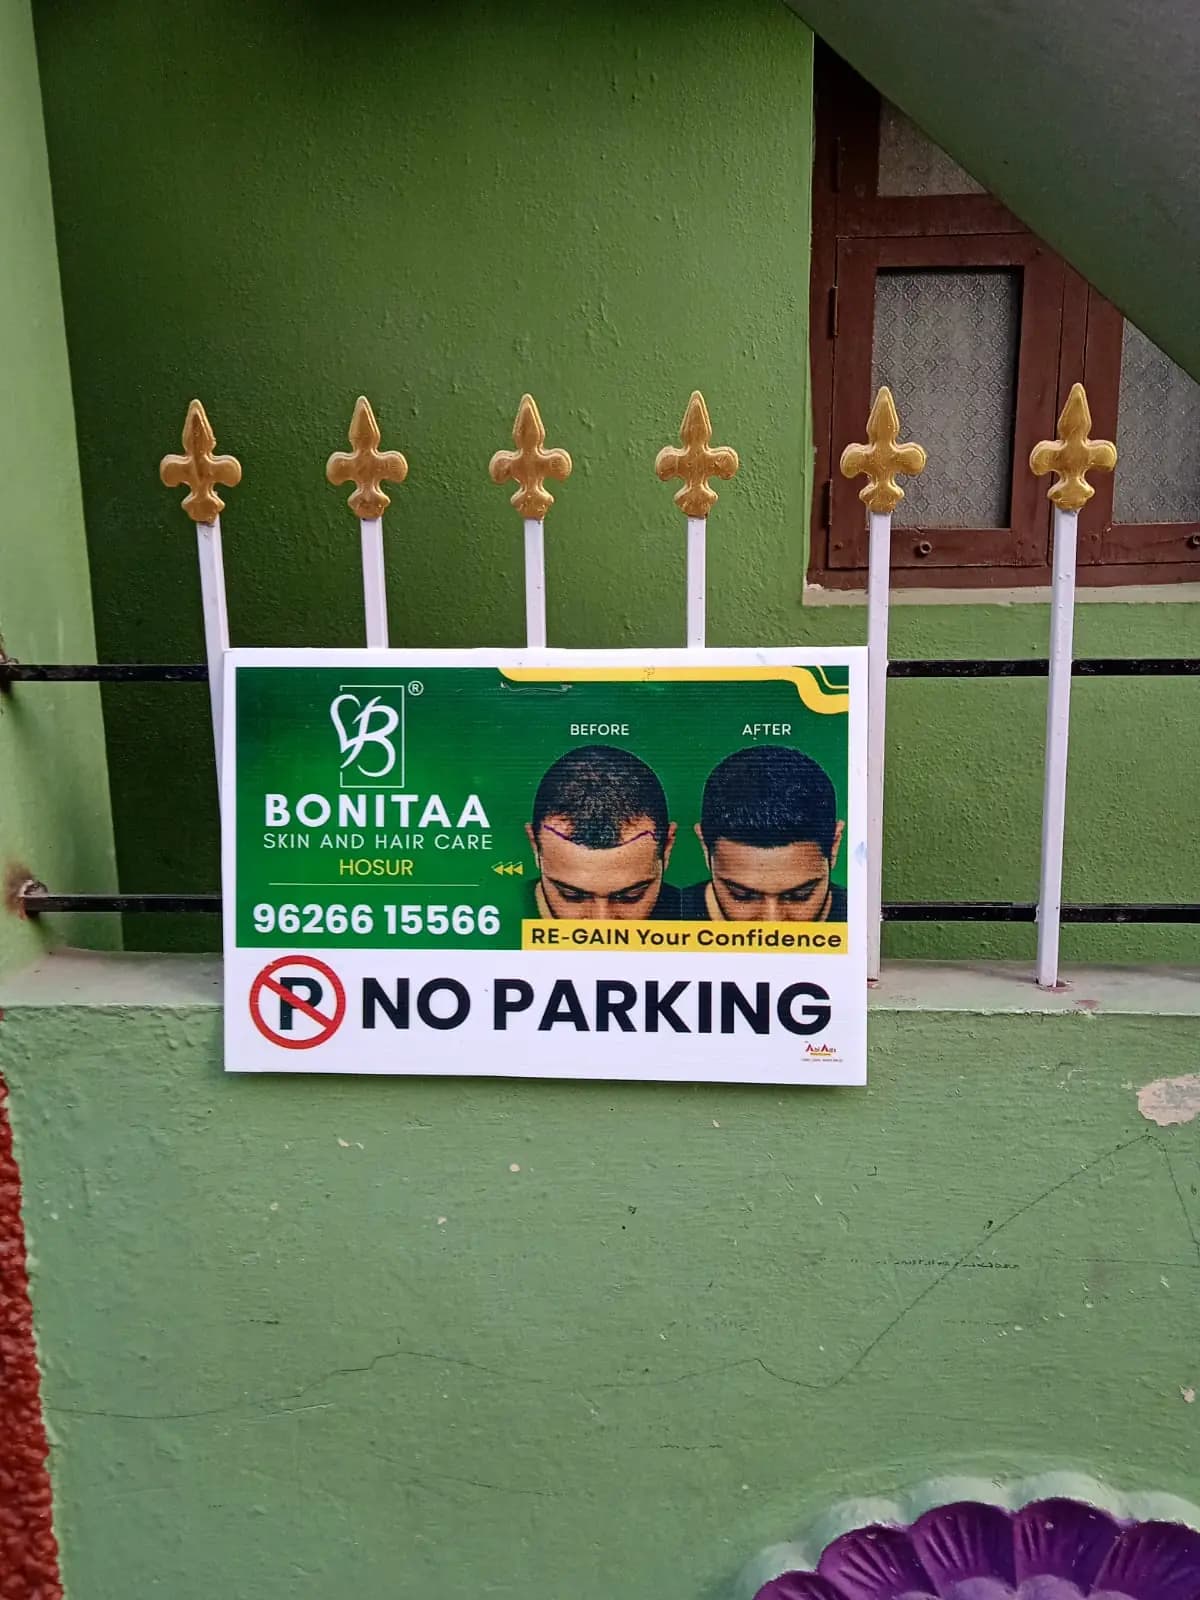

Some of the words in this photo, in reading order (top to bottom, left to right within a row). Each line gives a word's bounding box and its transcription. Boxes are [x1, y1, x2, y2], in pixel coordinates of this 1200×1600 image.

[569, 723, 630, 737] BEFORE
[742, 723, 792, 737] AFTER
[265, 793, 491, 828] BONITAA
[263, 833, 310, 849] SKIN
[320, 834, 365, 849] AND
[375, 834, 425, 850] HAIR
[434, 834, 494, 850] CARE
[339, 859, 414, 876] HOSUR
[253, 903, 374, 934] 96266
[384, 904, 501, 935] 15566
[531, 927, 630, 946] RE-GAIN
[636, 928, 691, 947] Your
[697, 929, 842, 948] Confidence
[280, 976, 323, 1030] P
[362, 977, 471, 1030] NO
[493, 979, 832, 1036] PARKING
